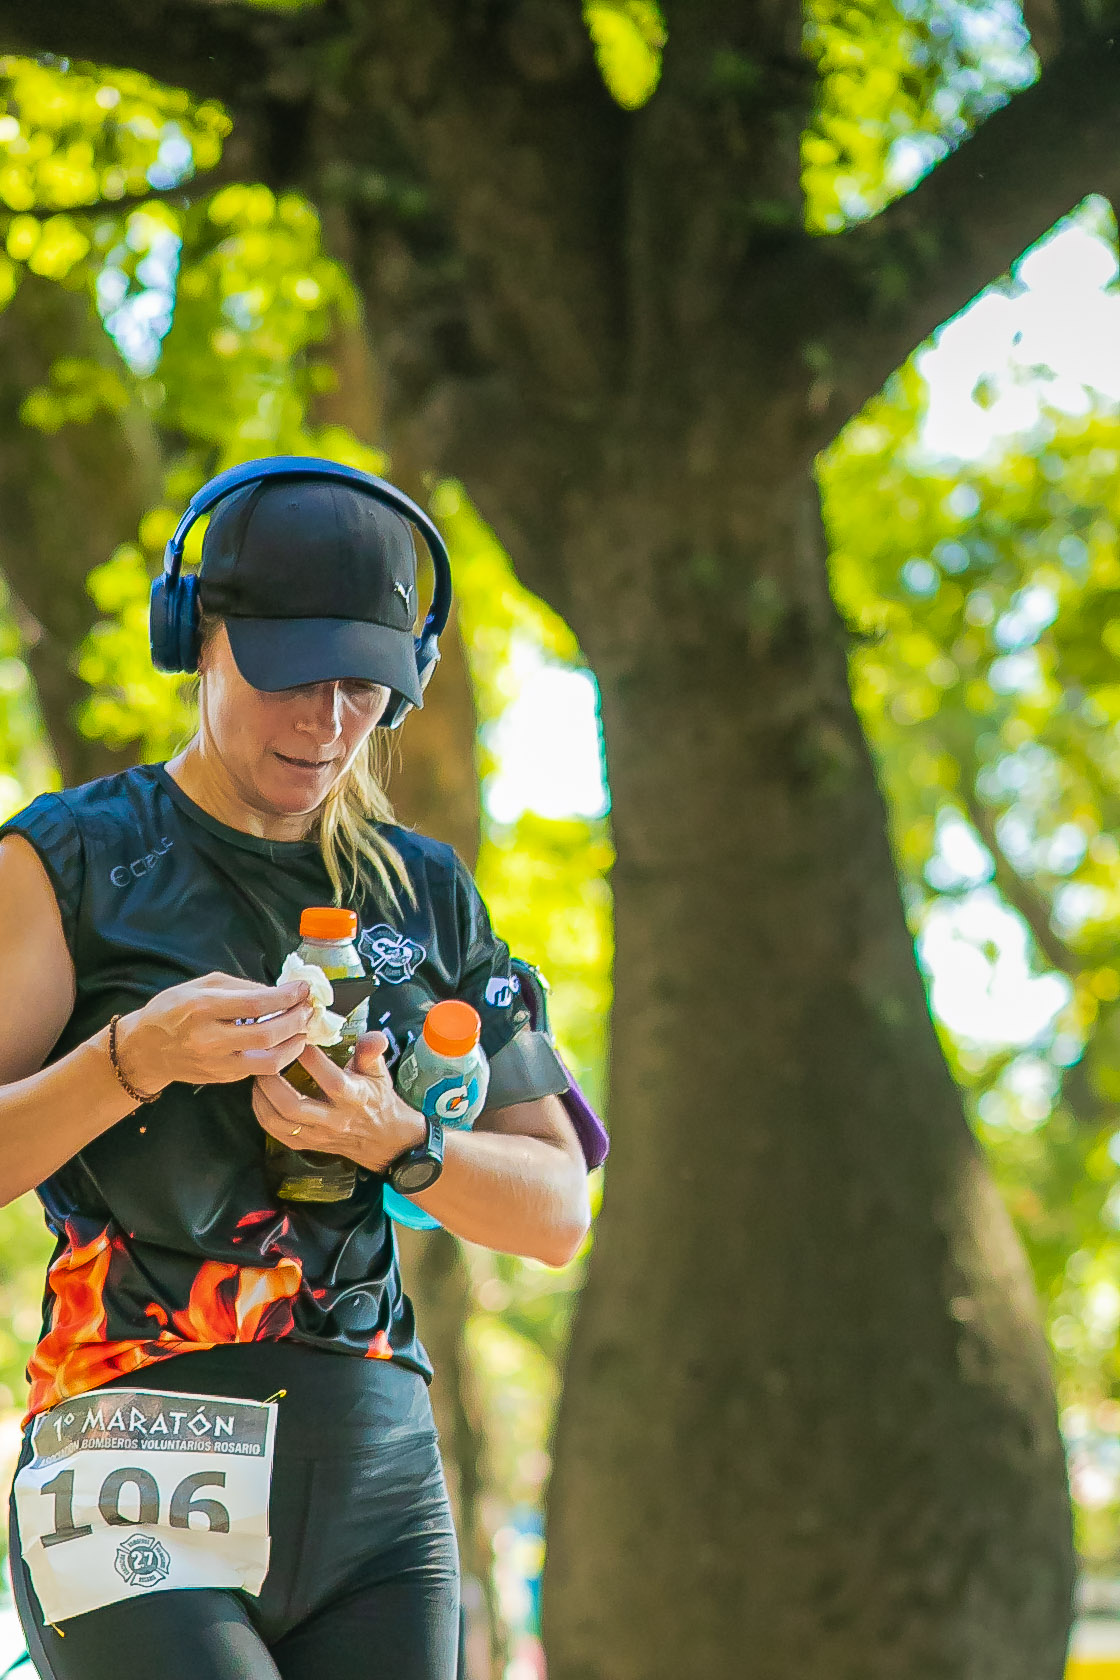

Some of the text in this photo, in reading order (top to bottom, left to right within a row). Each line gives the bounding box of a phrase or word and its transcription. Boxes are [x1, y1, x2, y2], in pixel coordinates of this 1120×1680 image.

[435, 1085, 469, 1119] G
[80, 1405, 235, 1437] MARATÓN
[81, 1437, 138, 1449] BOMBEROS
[140, 1439, 212, 1452] VOLUNTARIOS
[213, 1441, 261, 1455] ROSARIO
[40, 1467, 230, 1548] 106
[131, 1550, 154, 1569] 27
